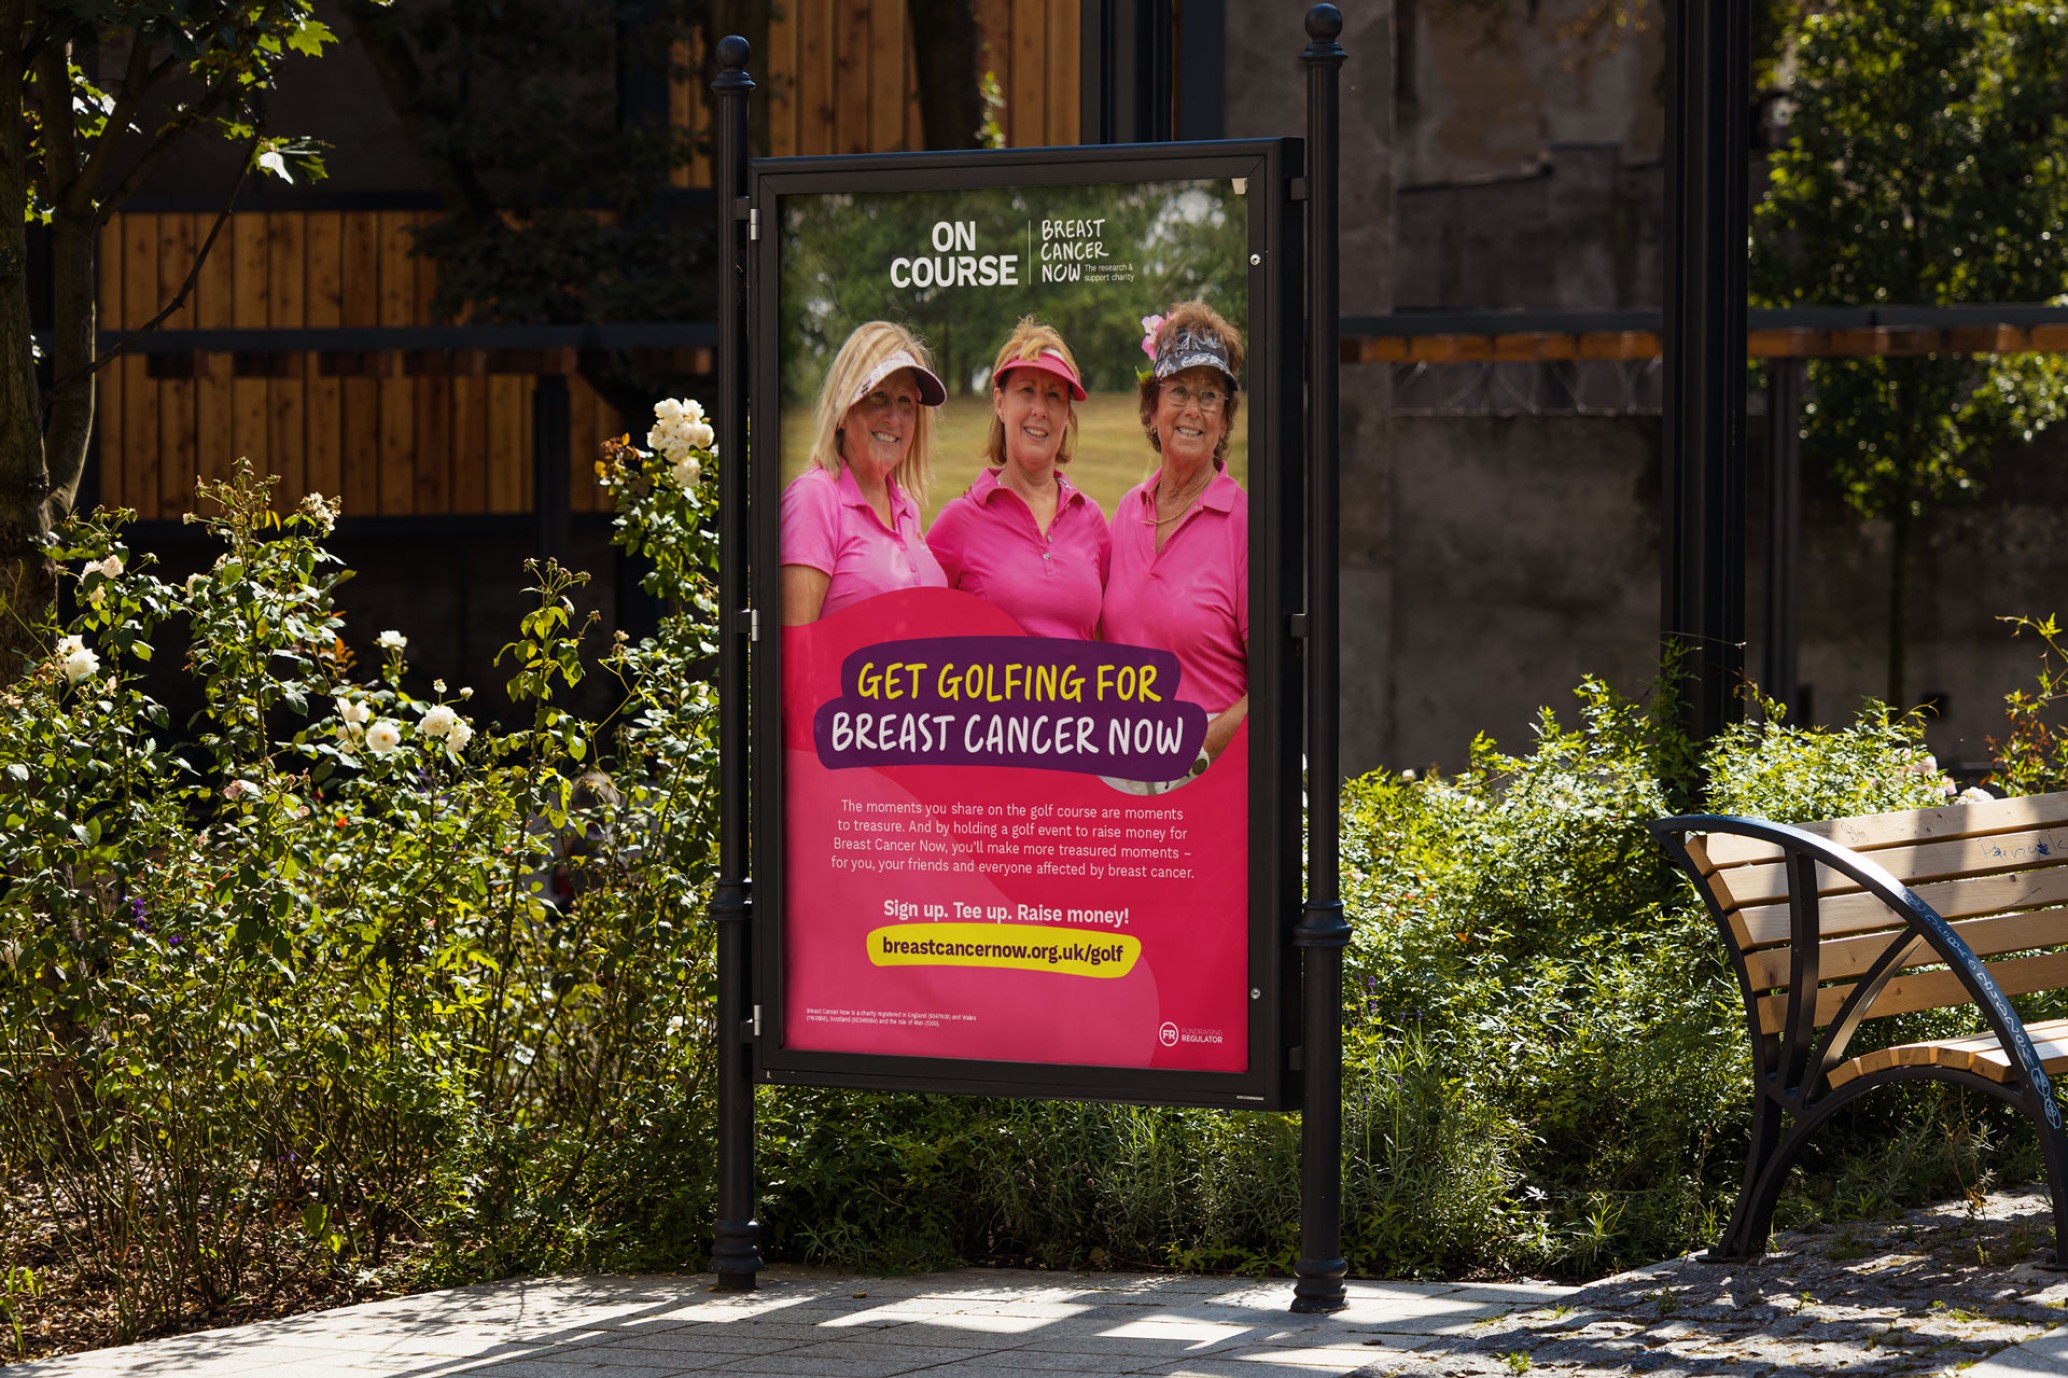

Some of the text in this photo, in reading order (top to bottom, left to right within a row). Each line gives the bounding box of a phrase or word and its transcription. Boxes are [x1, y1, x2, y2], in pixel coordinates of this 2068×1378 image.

[932, 220, 976, 252] ON
[1042, 219, 1106, 241] BREAST
[1040, 242, 1109, 261] CANCER
[890, 255, 1018, 288] COURSE
[1042, 263, 1081, 283] NOW
[1084, 272, 1134, 283] support charity
[1085, 264, 1096, 272] The
[1099, 264, 1127, 272] research
[858, 662, 1162, 703] GET GOLFING FOR
[831, 712, 1183, 755] BREAST CANCER NOW
[841, 800, 1183, 820] The moments you share on the golf course are moments
[838, 819, 1187, 842] to treasure. And by holding a golf event to raise money for
[834, 838, 871, 850] Breast
[875, 838, 915, 851] Cancer
[919, 840, 948, 854] Now,
[987, 841, 1019, 854] make
[1023, 844, 1055, 855] more
[1059, 844, 1117, 857] treasured
[1121, 846, 1179, 858] moments
[831, 856, 1194, 878] for you, your friends and everyone affected by breast cancer.
[884, 899, 1129, 927] Sign up. Tee up. Raise money!
[882, 936, 1124, 963] breastcancernow.org.uk/golf
[1163, 1030, 1175, 1039] FR
[1181, 1035, 1223, 1043] REGULATOR
